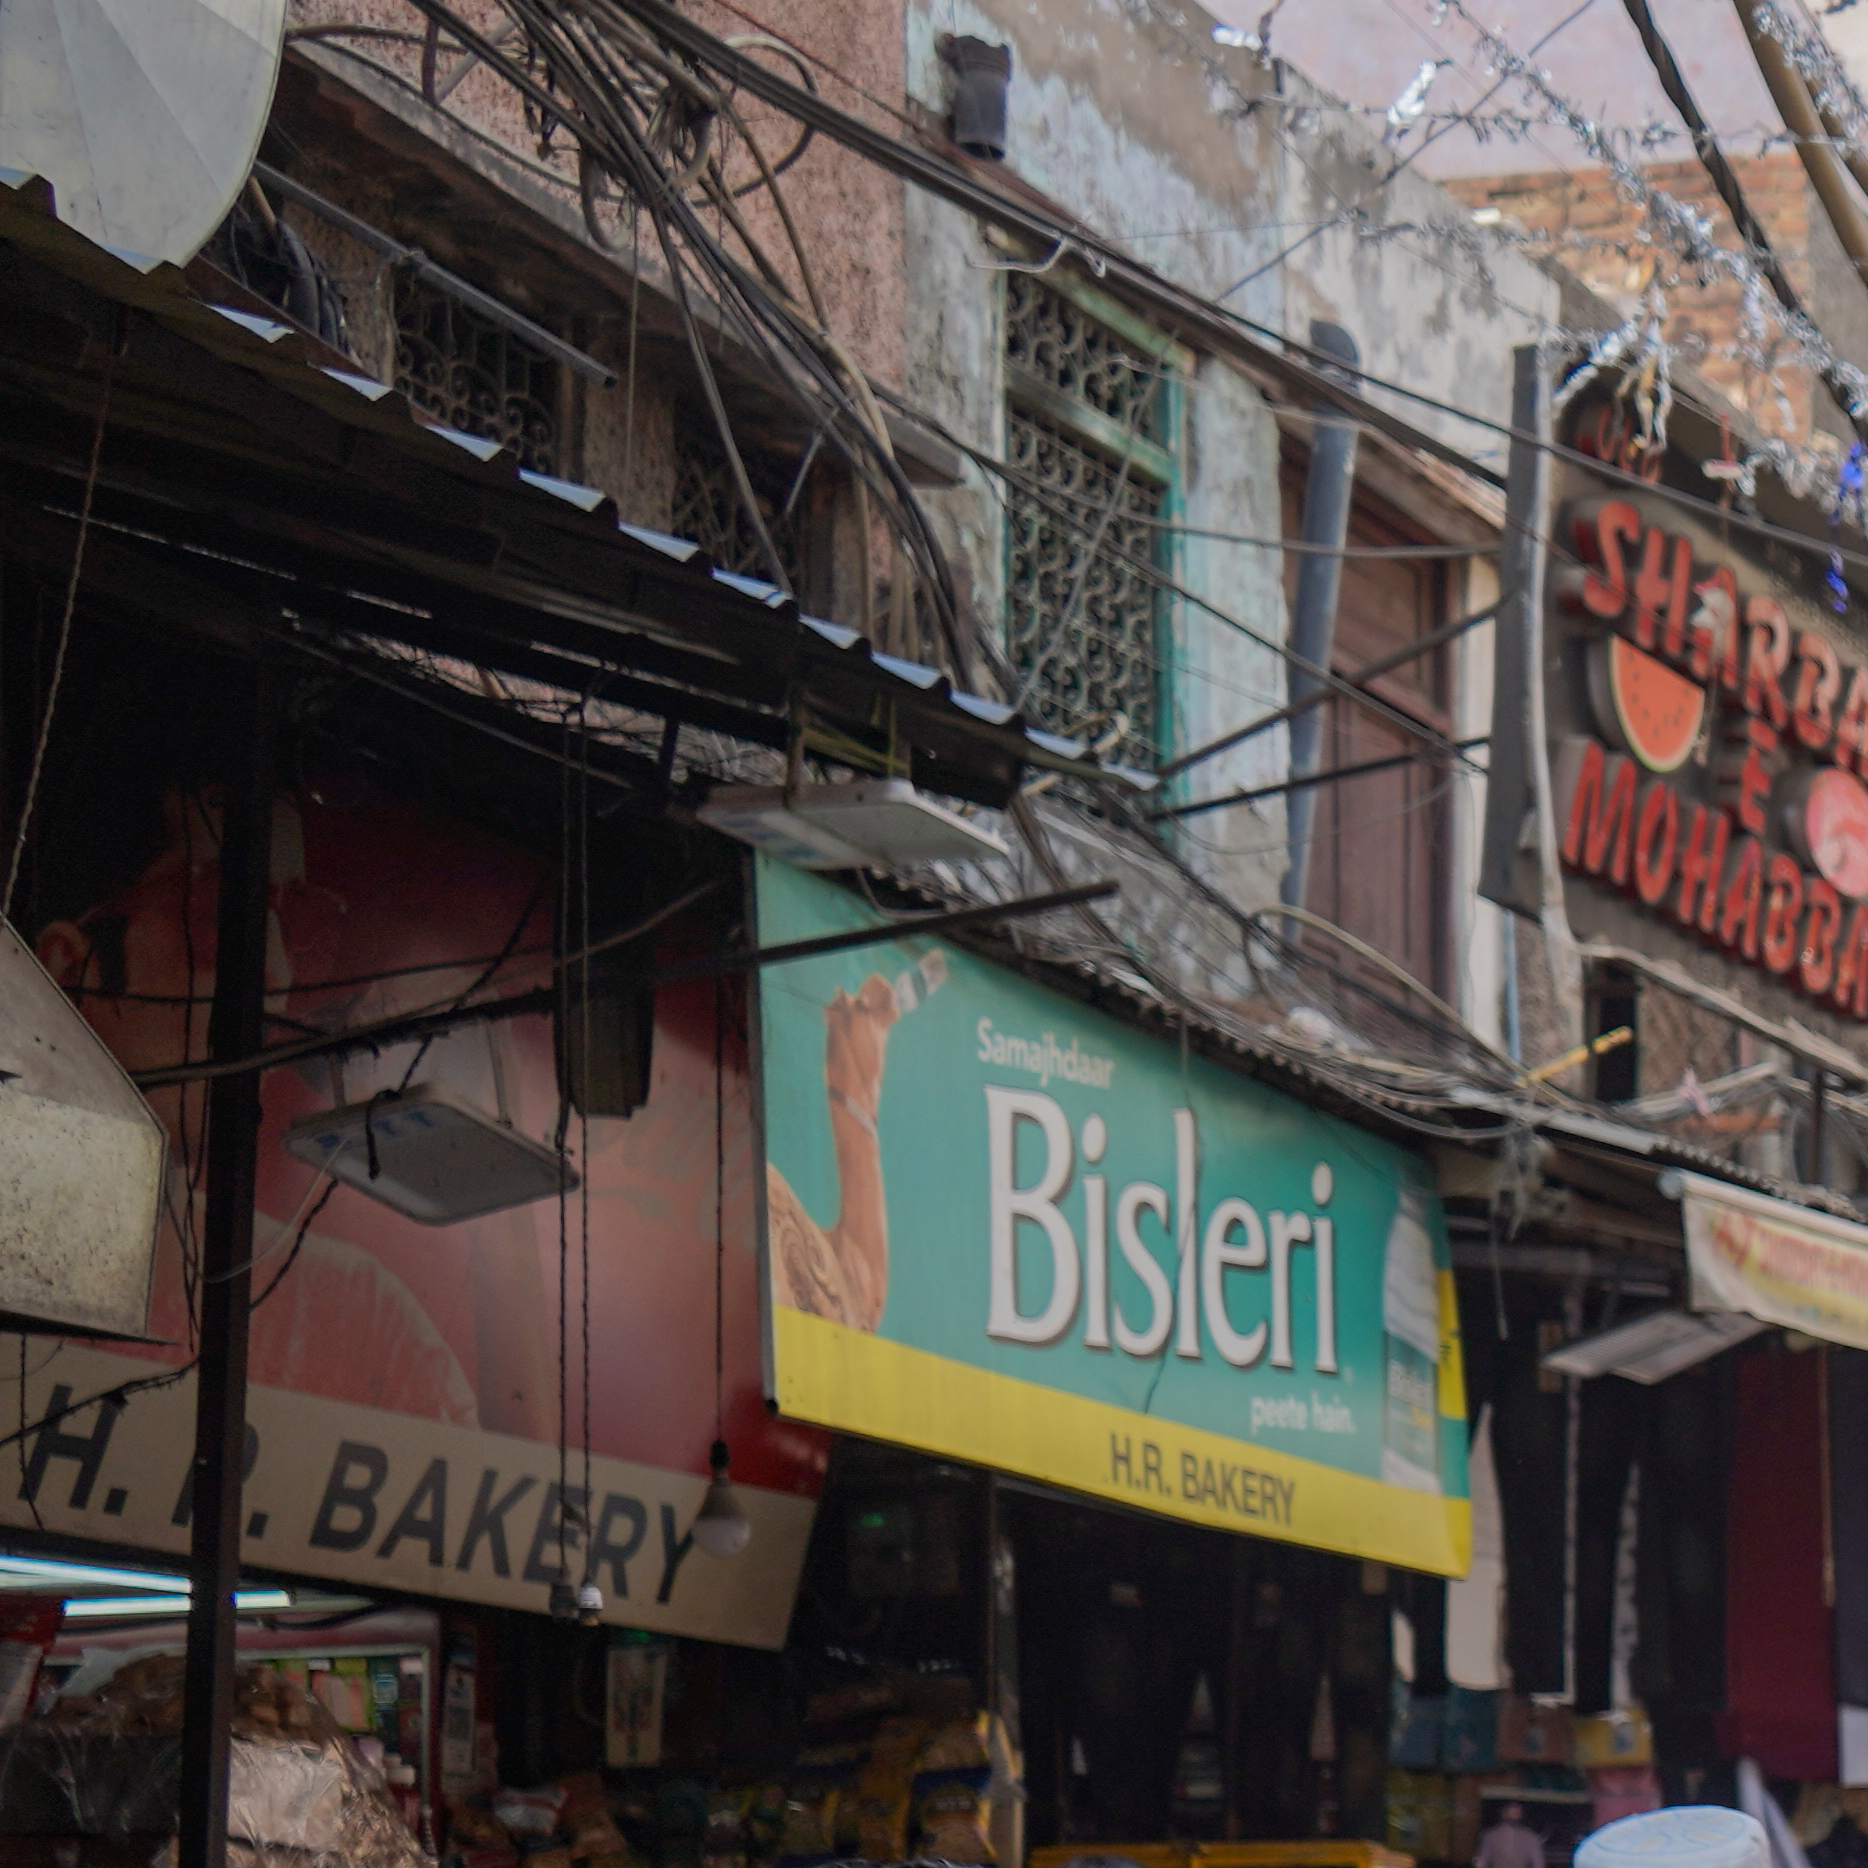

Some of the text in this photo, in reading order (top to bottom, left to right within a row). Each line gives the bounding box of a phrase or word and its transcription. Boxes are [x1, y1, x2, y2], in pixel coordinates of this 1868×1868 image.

[976, 1015, 1116, 1090] Samajhdaar
[984, 1083, 1340, 1374] Bisleri
[1250, 1393, 1308, 1438] peete
[308, 1438, 698, 1606] BAKERY
[1109, 1434, 1296, 1528] H.R. BAKERY
